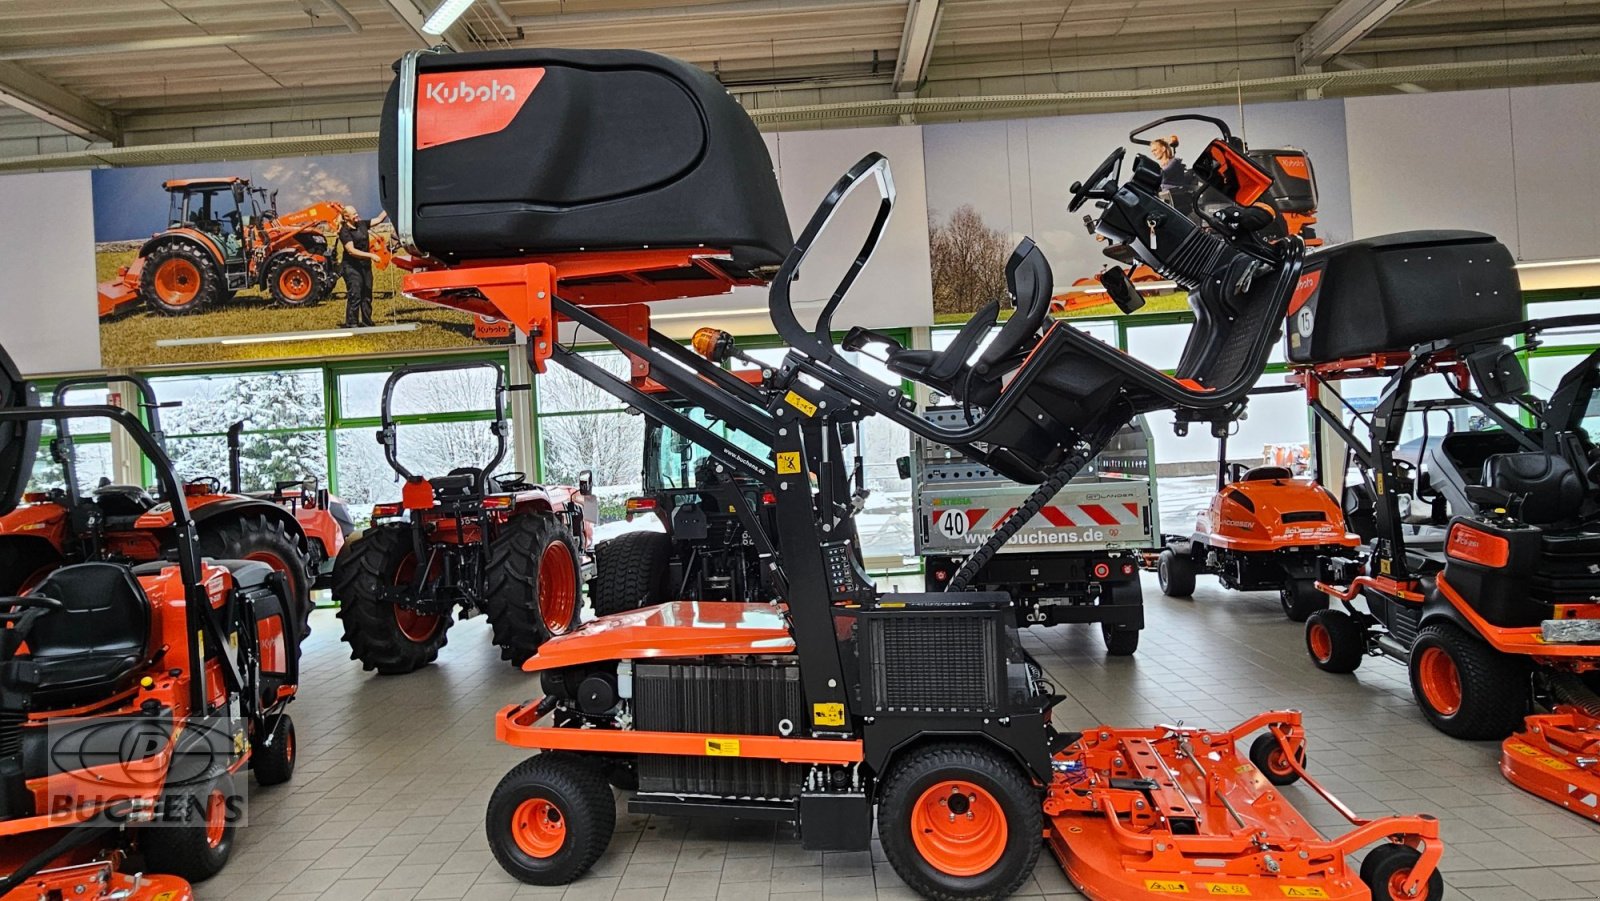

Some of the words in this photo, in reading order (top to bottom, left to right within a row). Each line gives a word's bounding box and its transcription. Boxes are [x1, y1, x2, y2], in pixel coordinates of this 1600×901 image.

[426, 79, 516, 104] Kubota
[478, 326, 506, 334] Kubota
[1301, 312, 1310, 331] 15
[723, 447, 766, 475] www.buchens.de
[944, 512, 964, 536] 40
